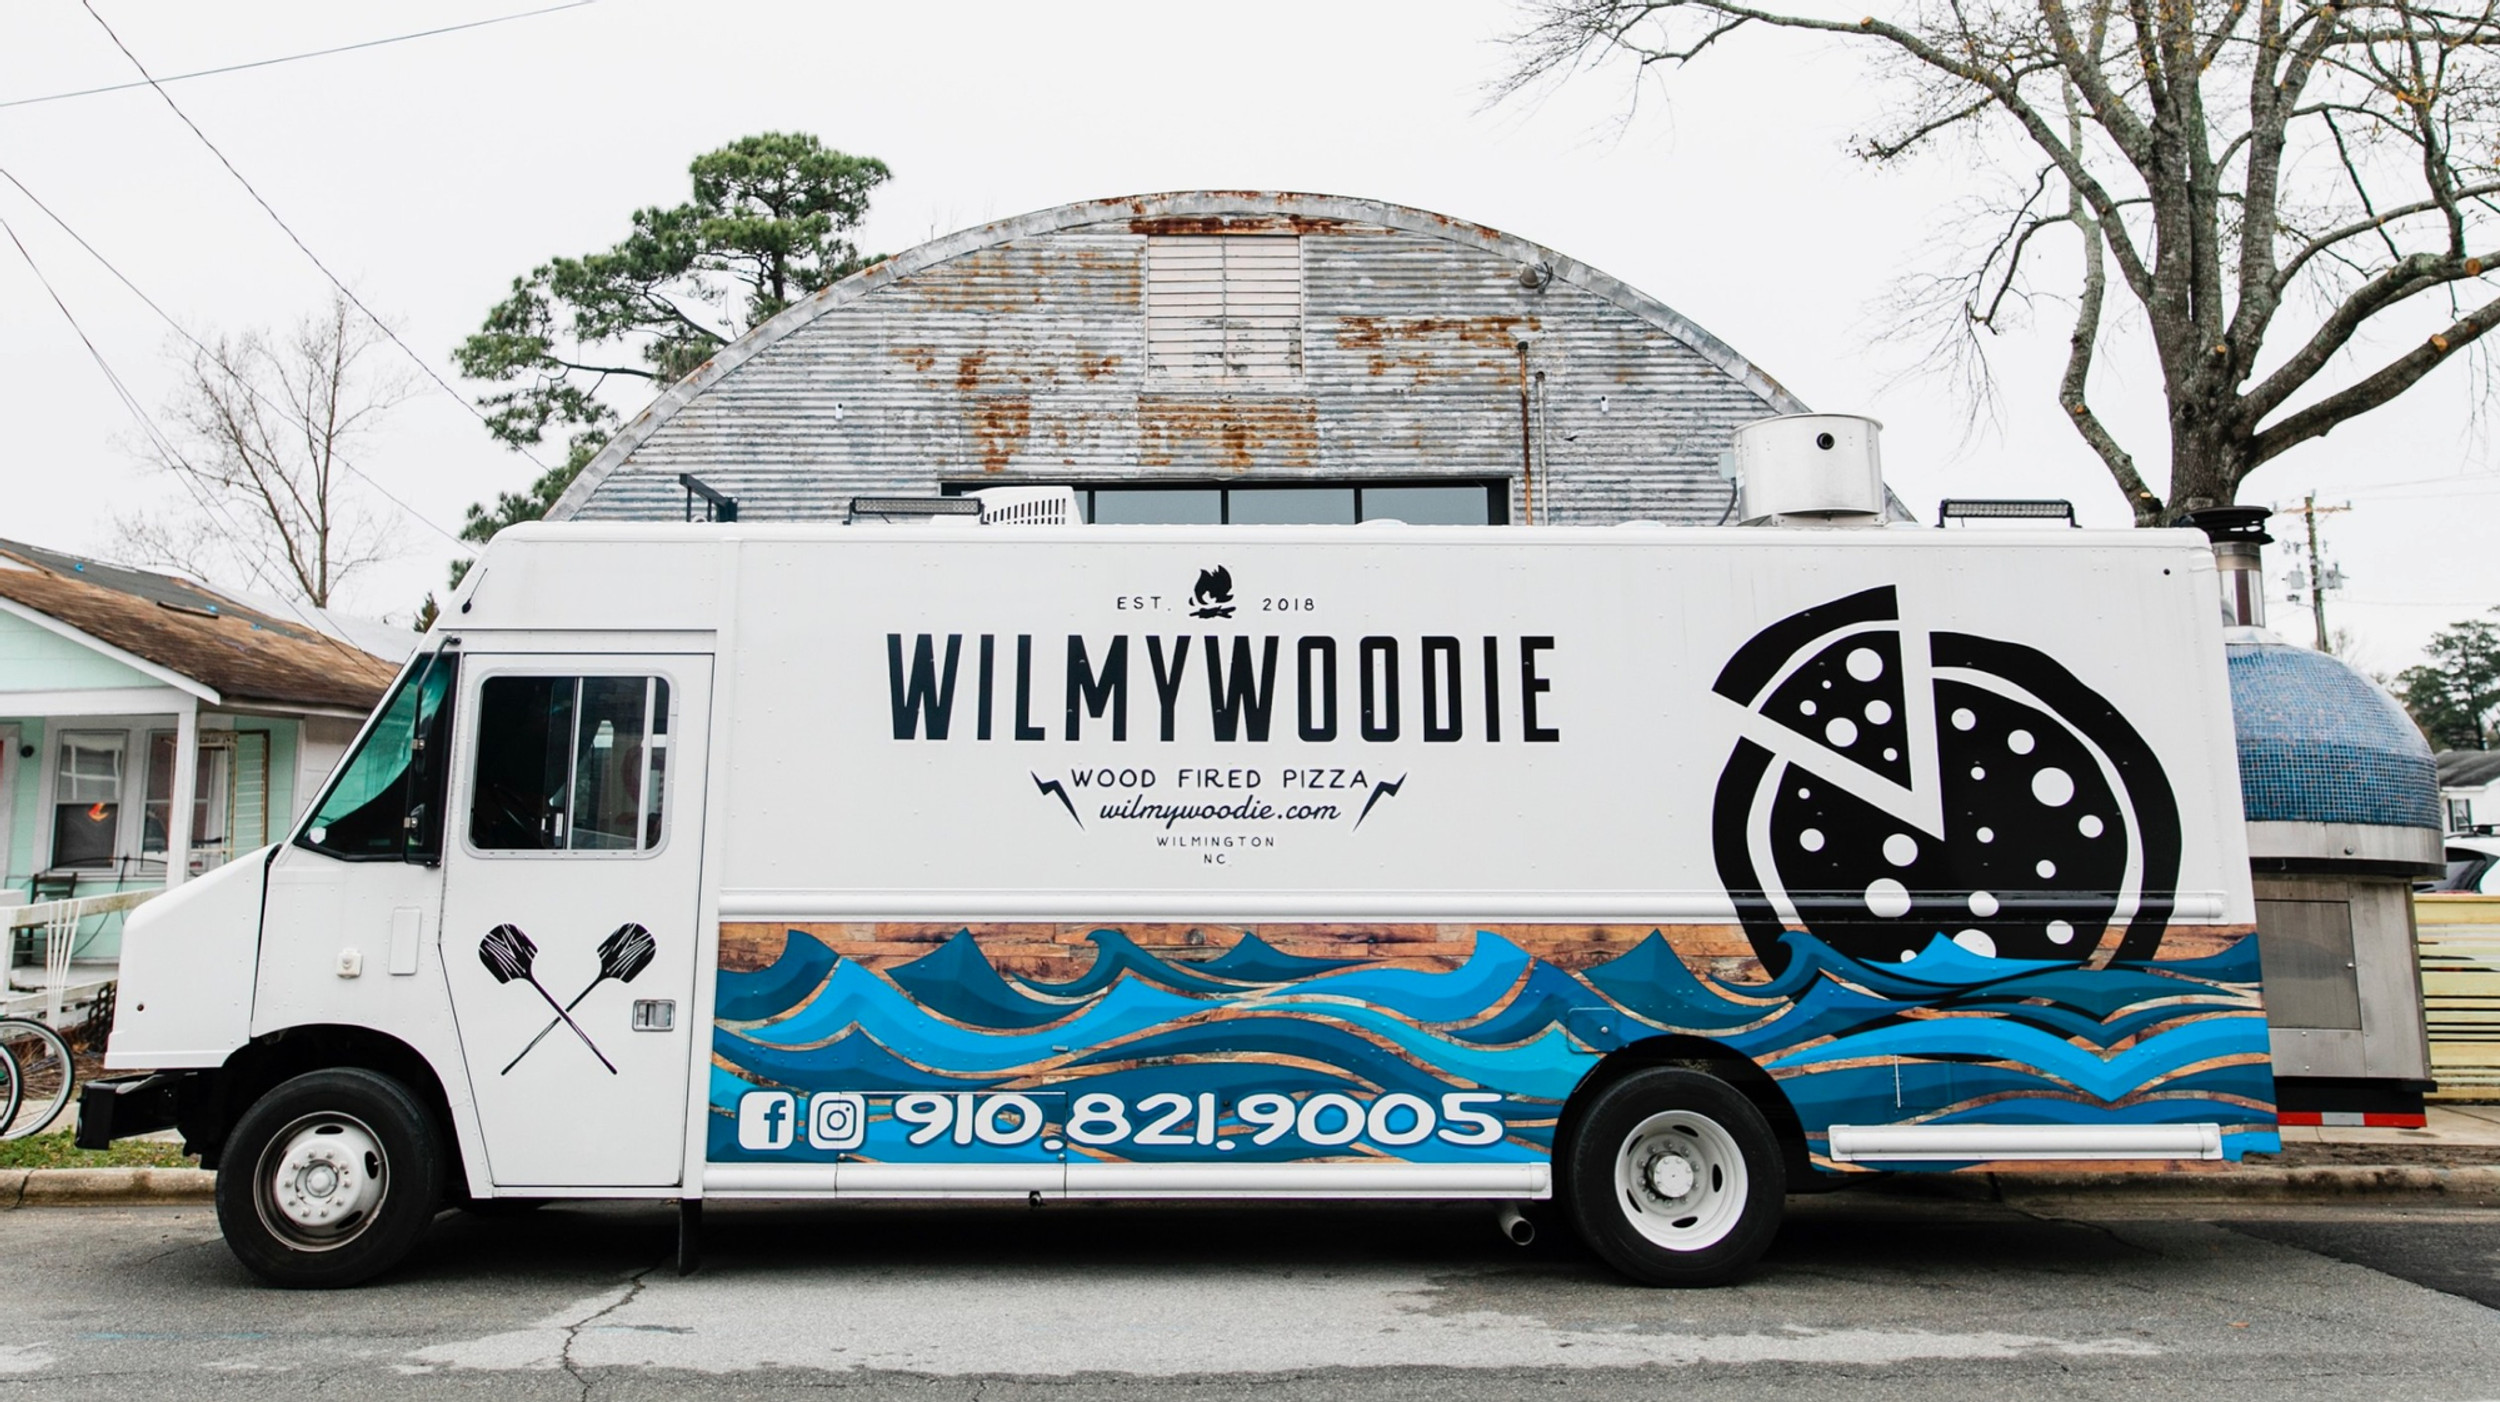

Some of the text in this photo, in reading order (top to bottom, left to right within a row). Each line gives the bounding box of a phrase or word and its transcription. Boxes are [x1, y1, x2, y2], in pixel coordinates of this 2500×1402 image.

[1116, 595, 1316, 612] EST. 2018
[886, 633, 1560, 743] WILMYWOODIE
[1070, 768, 1369, 790] WOOD FIRED PIZZA
[1099, 793, 1342, 830] wilmywoodie.com
[1156, 836, 1275, 848] WILMINGTON
[1203, 853, 1227, 865] NC
[894, 1091, 1503, 1151] 910.821.9005
